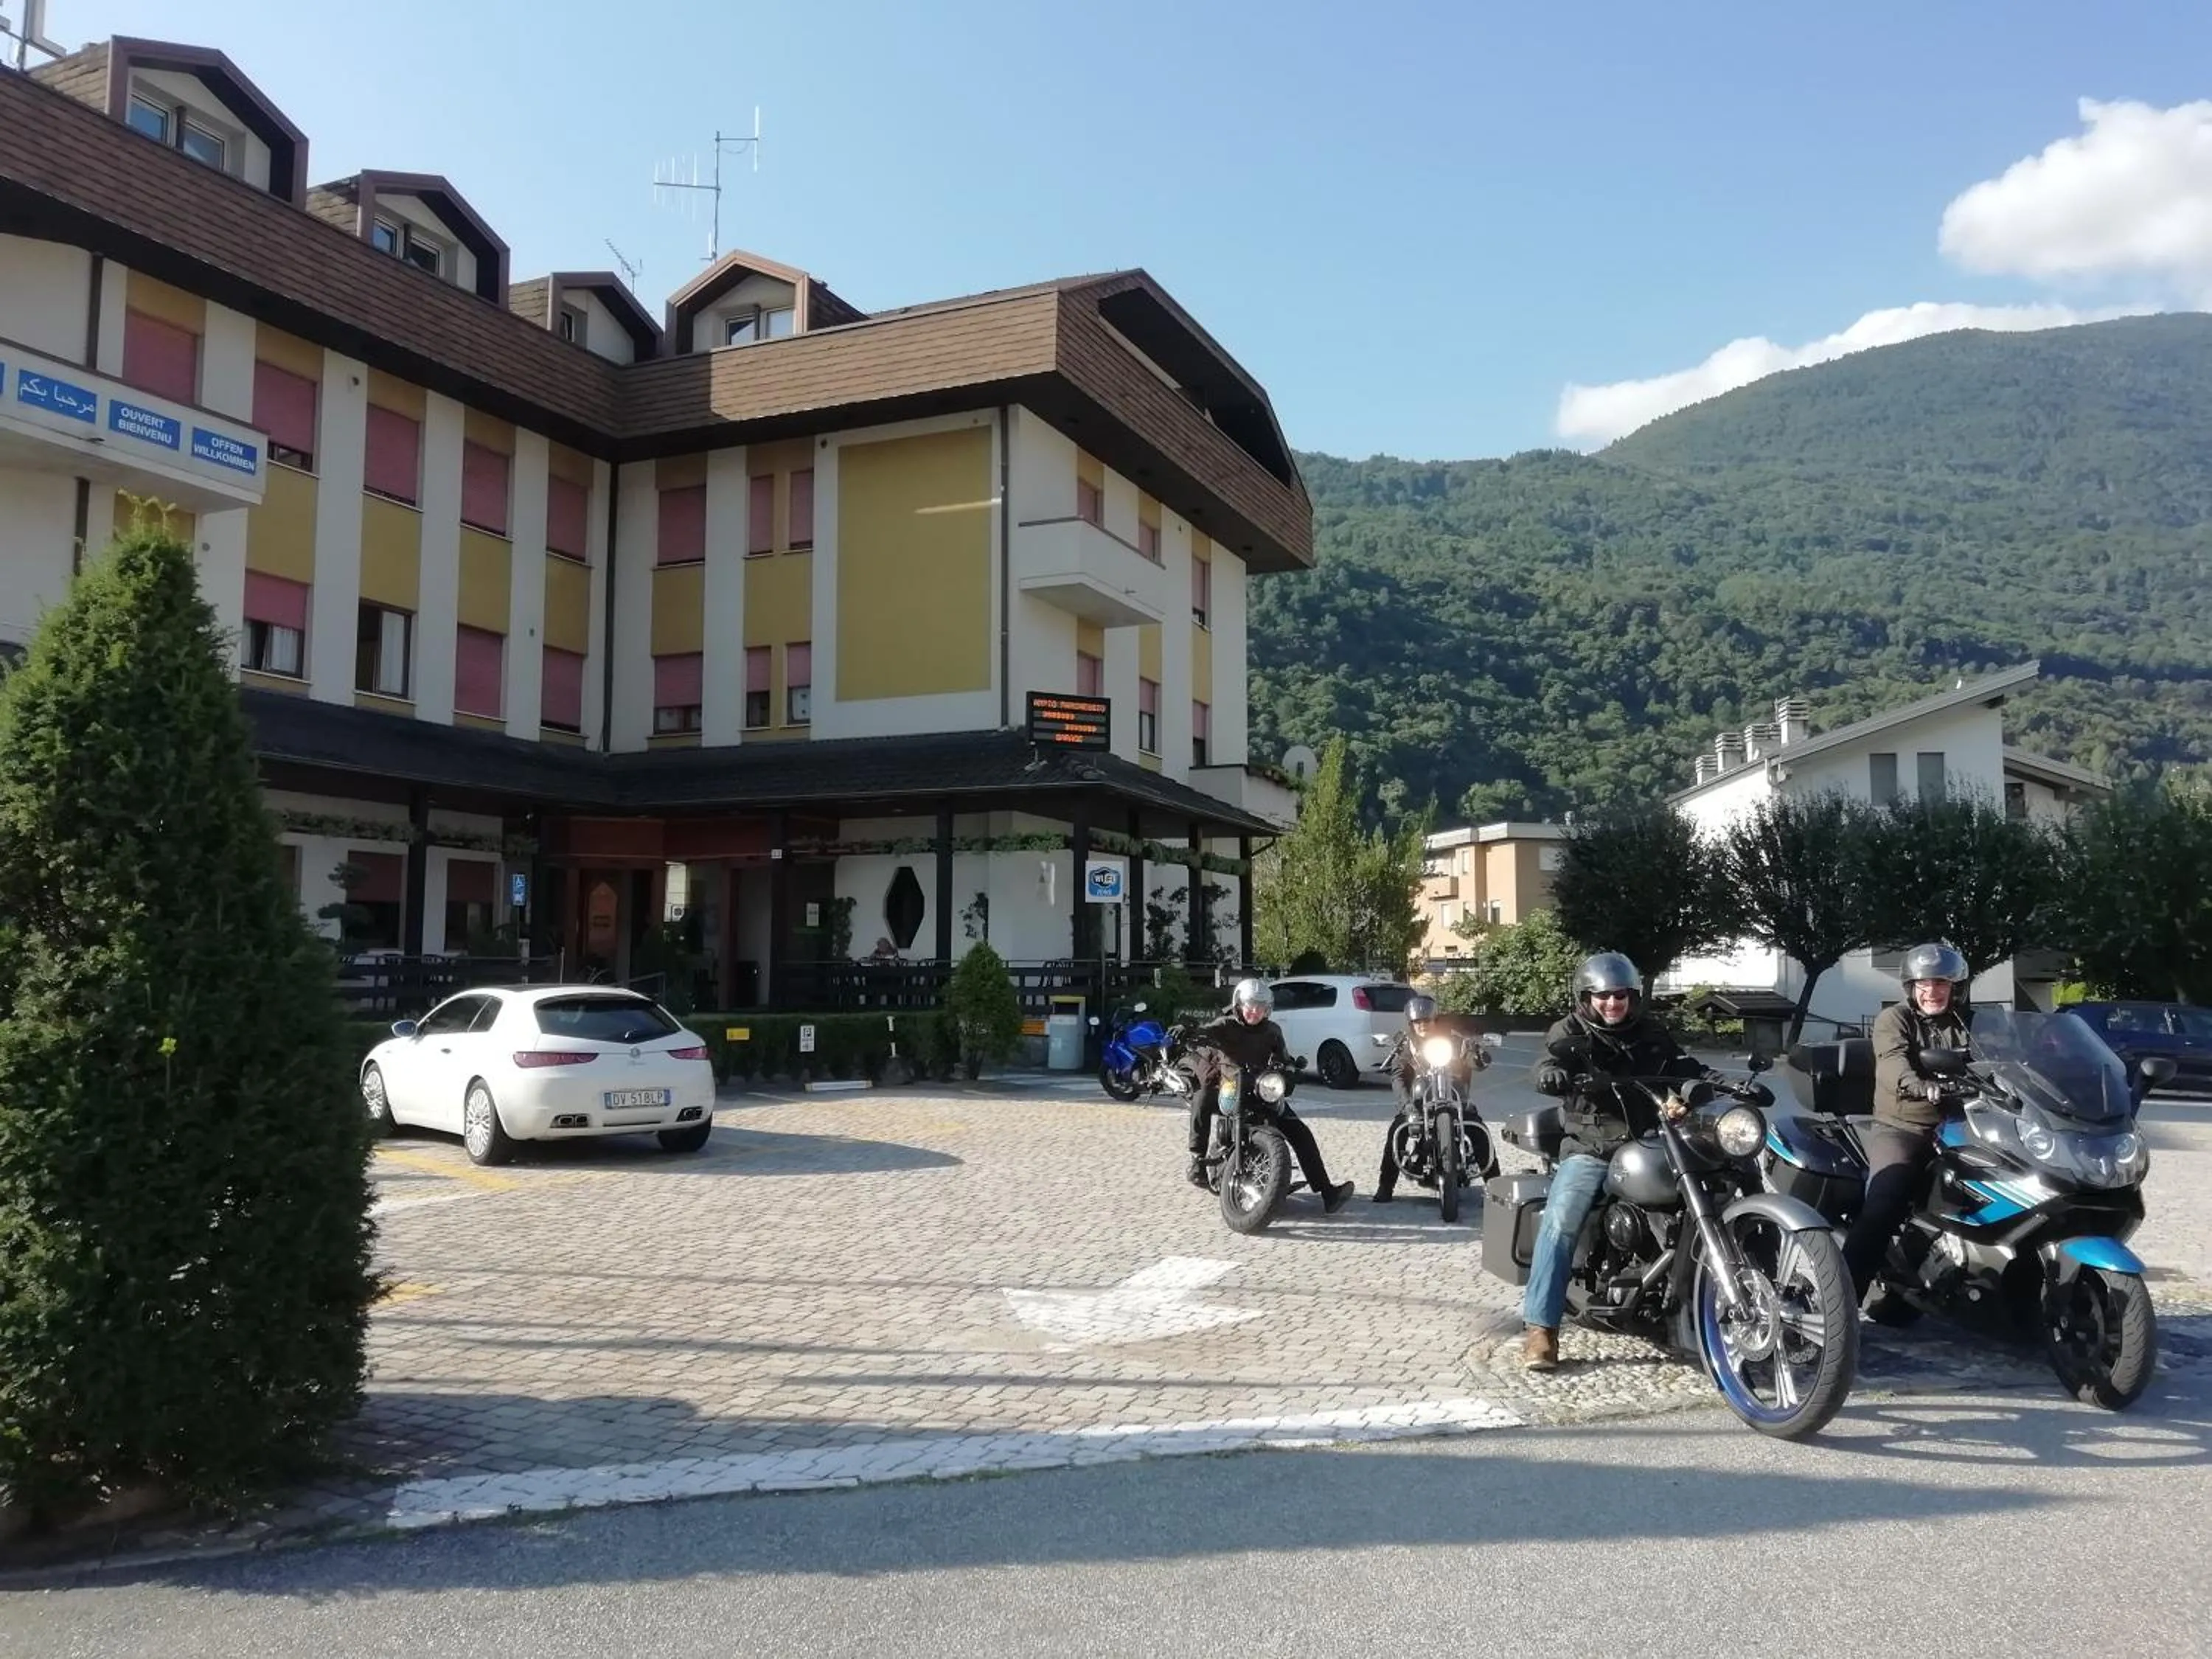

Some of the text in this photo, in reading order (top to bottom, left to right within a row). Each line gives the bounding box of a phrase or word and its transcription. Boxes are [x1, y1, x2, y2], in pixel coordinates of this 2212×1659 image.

[120, 408, 165, 430] OUVERT
[118, 419, 173, 444] BIENVENU
[194, 444, 255, 470] WILLKOMMEN
[212, 437, 244, 456] OFFEN
[613, 1093, 626, 1105] DV
